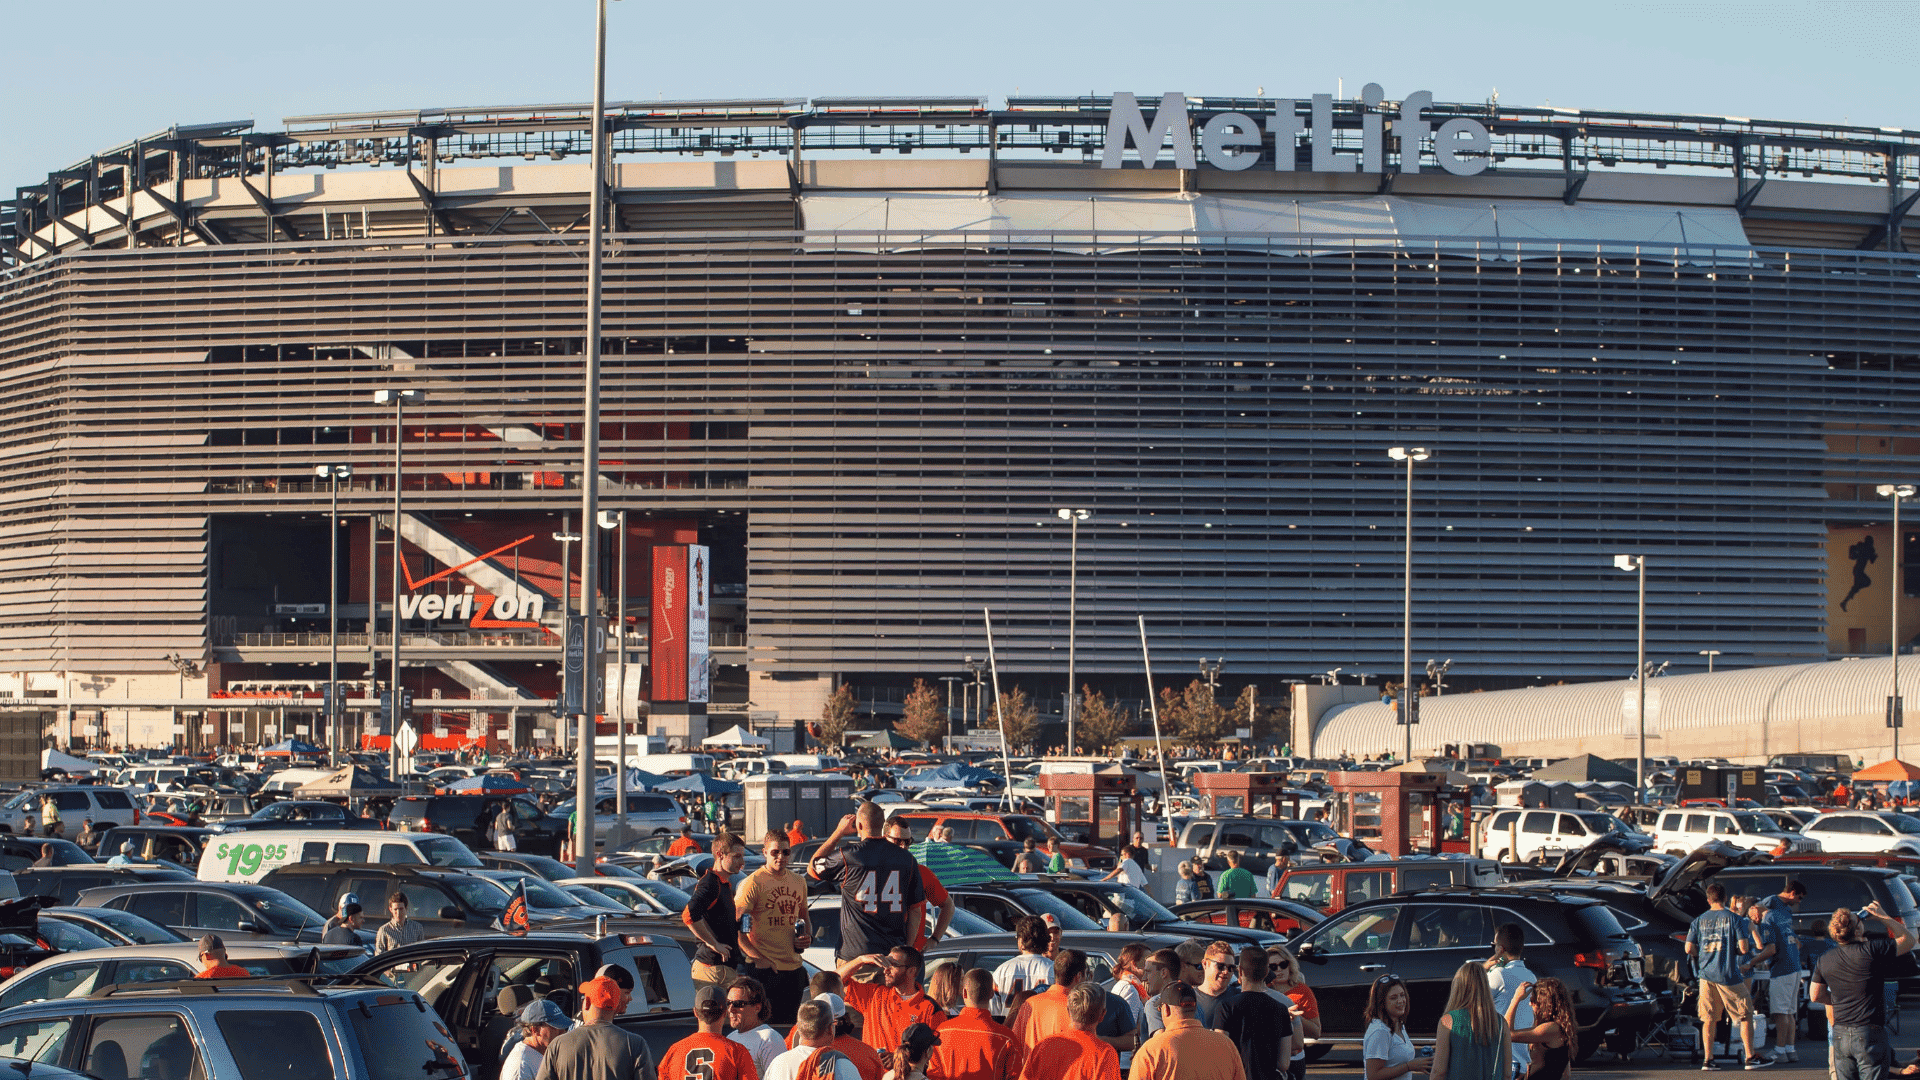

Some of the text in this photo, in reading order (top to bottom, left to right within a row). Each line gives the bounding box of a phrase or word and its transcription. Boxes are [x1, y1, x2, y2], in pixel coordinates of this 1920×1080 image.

[1101, 83, 1492, 176] MetLife
[663, 567, 675, 609] verizon
[399, 585, 544, 628] verizon
[340, 686, 345, 695] E
[403, 695, 411, 708] E
[596, 677, 603, 704] 8
[855, 870, 902, 912] 44
[767, 916, 785, 926] THE
[684, 1047, 715, 1080] S
